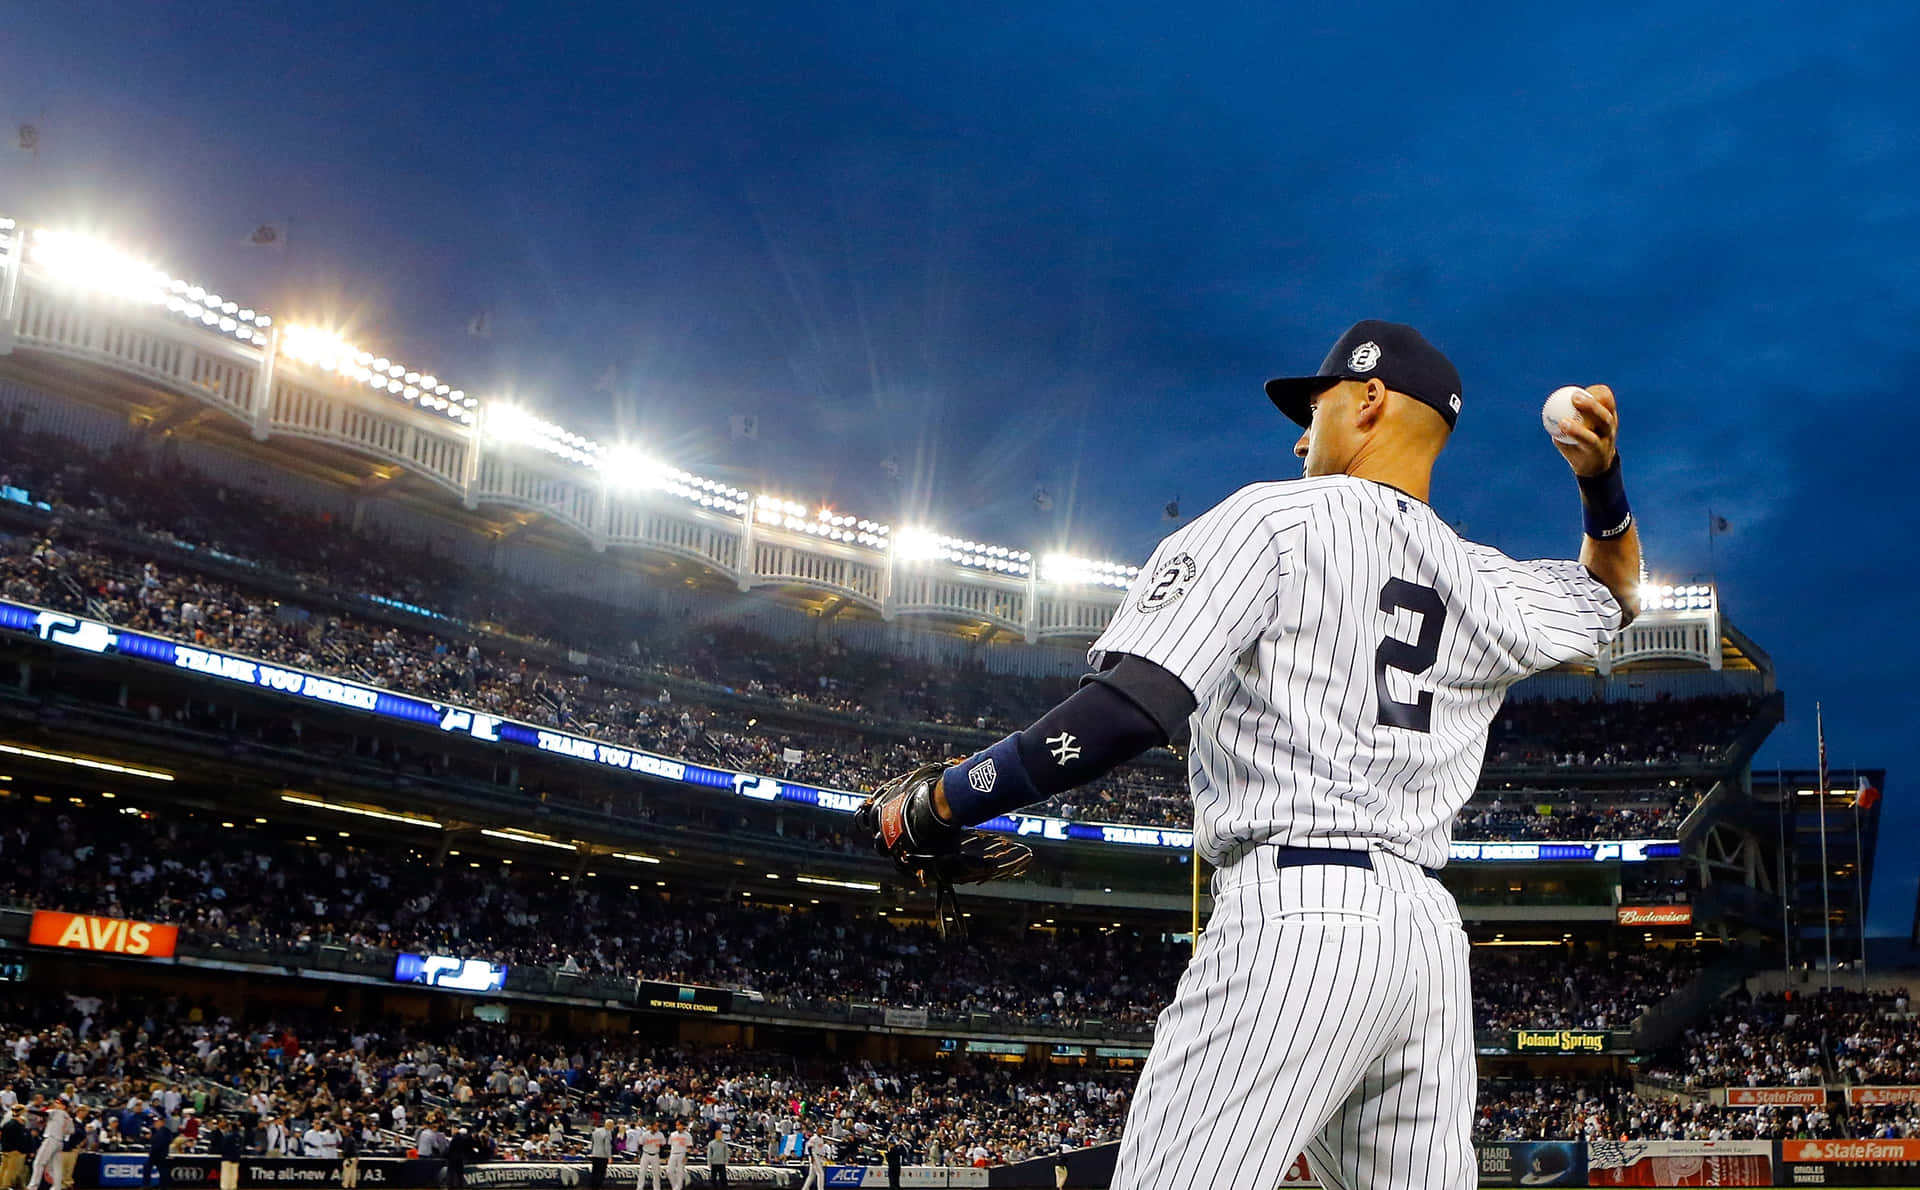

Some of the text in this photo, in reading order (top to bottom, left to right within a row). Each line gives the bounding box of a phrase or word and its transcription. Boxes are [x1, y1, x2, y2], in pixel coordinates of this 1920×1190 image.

[1356, 349, 1371, 366] 2
[1147, 568, 1180, 601] 2
[1374, 576, 1448, 734] 2
[175, 646, 256, 683] THANK
[258, 665, 304, 693] YOU
[537, 731, 597, 760] THANK
[597, 745, 631, 768] YOU
[1102, 827, 1194, 848] THANK YOU
[1618, 910, 1690, 925] Budweiser
[58, 915, 152, 955] AVIS
[663, 1001, 676, 1009] YORK
[676, 1002, 692, 1010] STOCK
[693, 1004, 718, 1013] EXCHANGE
[1517, 1031, 1604, 1051] Poland Spring
[1482, 1147, 1512, 1160] HARD.
[250, 1167, 275, 1181] The
[278, 1166, 326, 1181] all-new
[363, 1168, 386, 1181] A3.
[464, 1168, 559, 1184] WEATHERPROOF
[832, 1169, 860, 1181] ACC
[1793, 1166, 1824, 1174] ORIOLES
[1793, 1175, 1825, 1183] YANKEES
